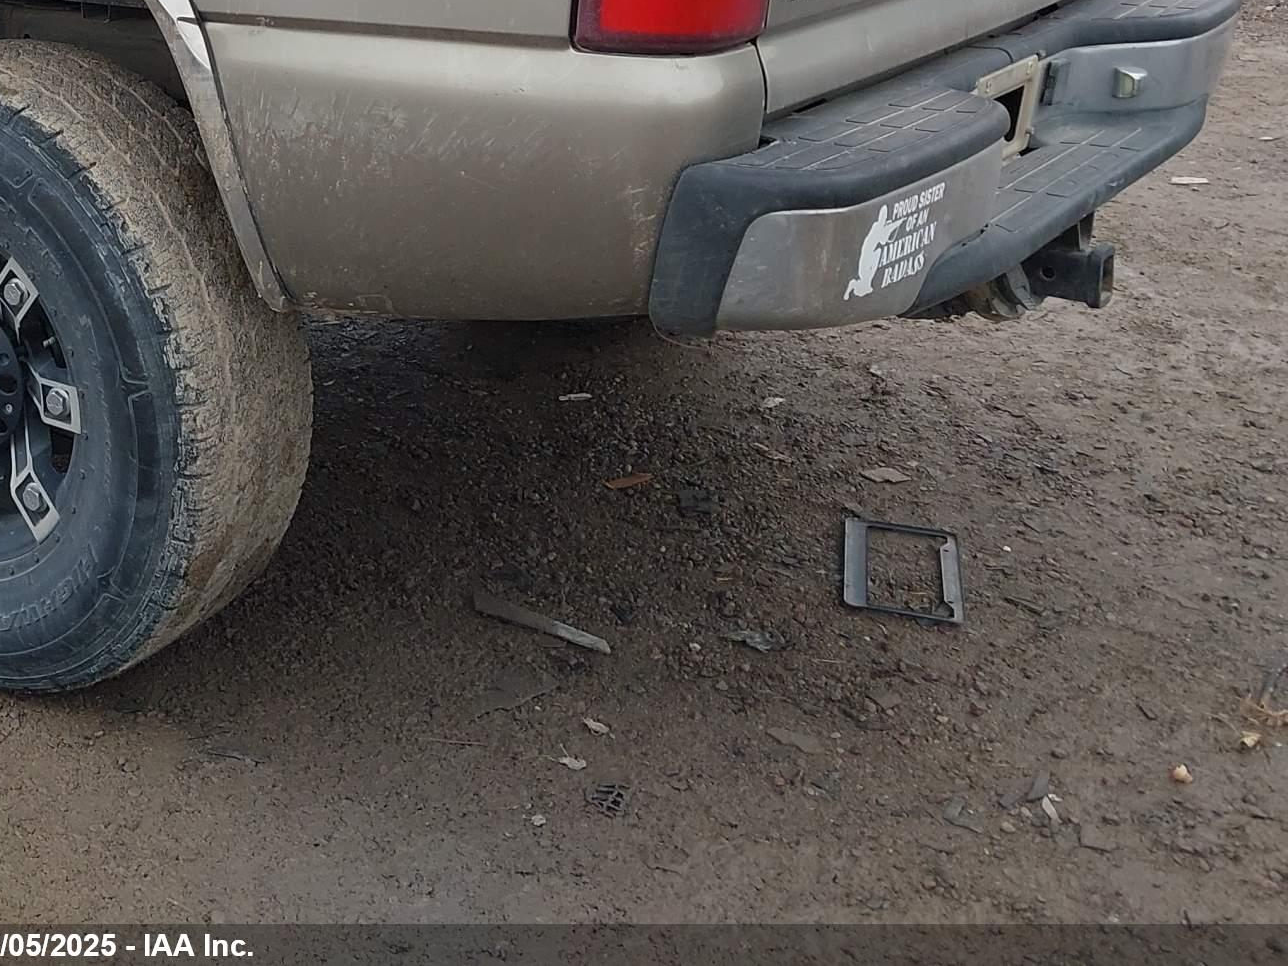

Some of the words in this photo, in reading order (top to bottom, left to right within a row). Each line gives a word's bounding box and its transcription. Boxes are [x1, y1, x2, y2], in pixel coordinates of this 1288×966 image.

[892, 194, 919, 221] PROUD
[918, 182, 946, 209] SISTER
[906, 213, 918, 232] OF
[916, 207, 930, 227] AN
[878, 221, 937, 268] AMERICAN
[881, 250, 925, 289] BADASS
